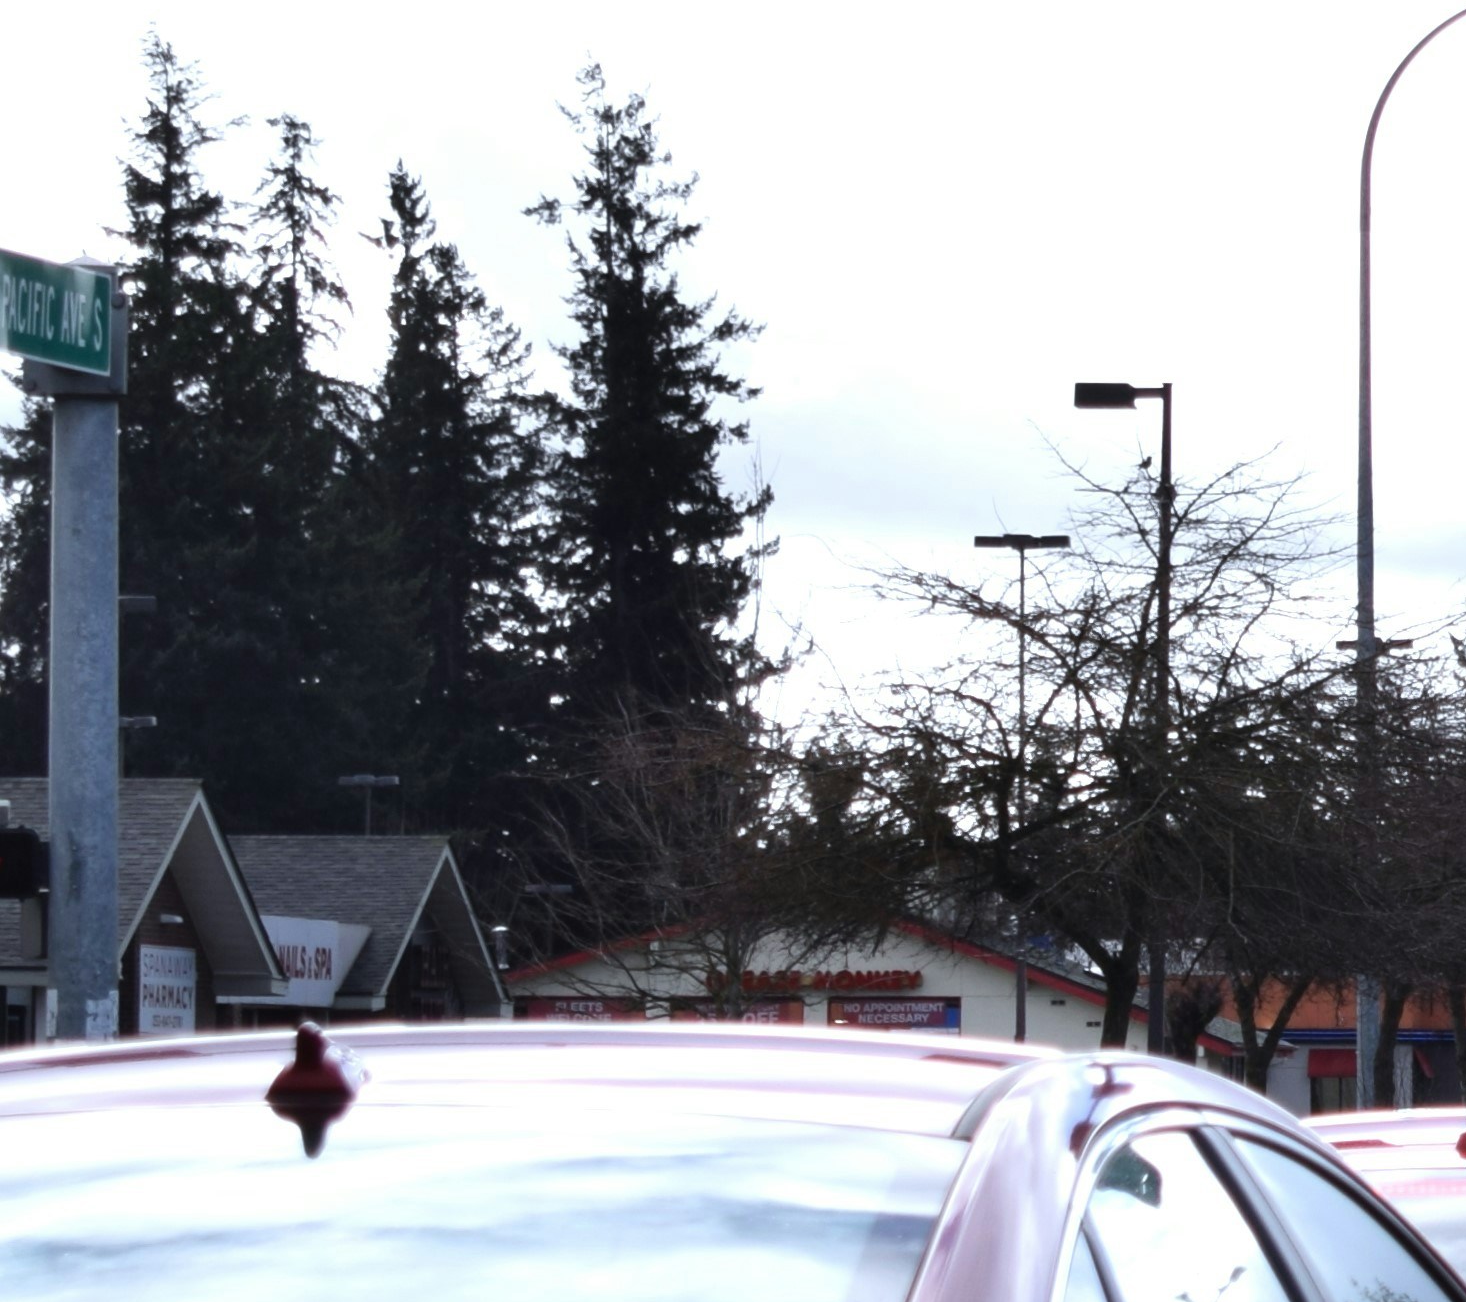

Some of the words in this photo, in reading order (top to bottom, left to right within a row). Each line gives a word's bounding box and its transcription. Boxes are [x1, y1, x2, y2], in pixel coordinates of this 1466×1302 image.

[1, 274, 55, 341] PACIFIC
[61, 290, 86, 348] AVE
[93, 298, 103, 352] S
[143, 953, 193, 978] SPANAWAY
[278, 945, 307, 979] NAILS
[314, 947, 333, 980] SPA
[706, 970, 802, 991] GEASE
[142, 983, 193, 1010] PHARMACY
[844, 1004, 860, 1013] NO
[864, 1002, 944, 1013] APPOINTMENT
[858, 1014, 930, 1024] NECESSARY
